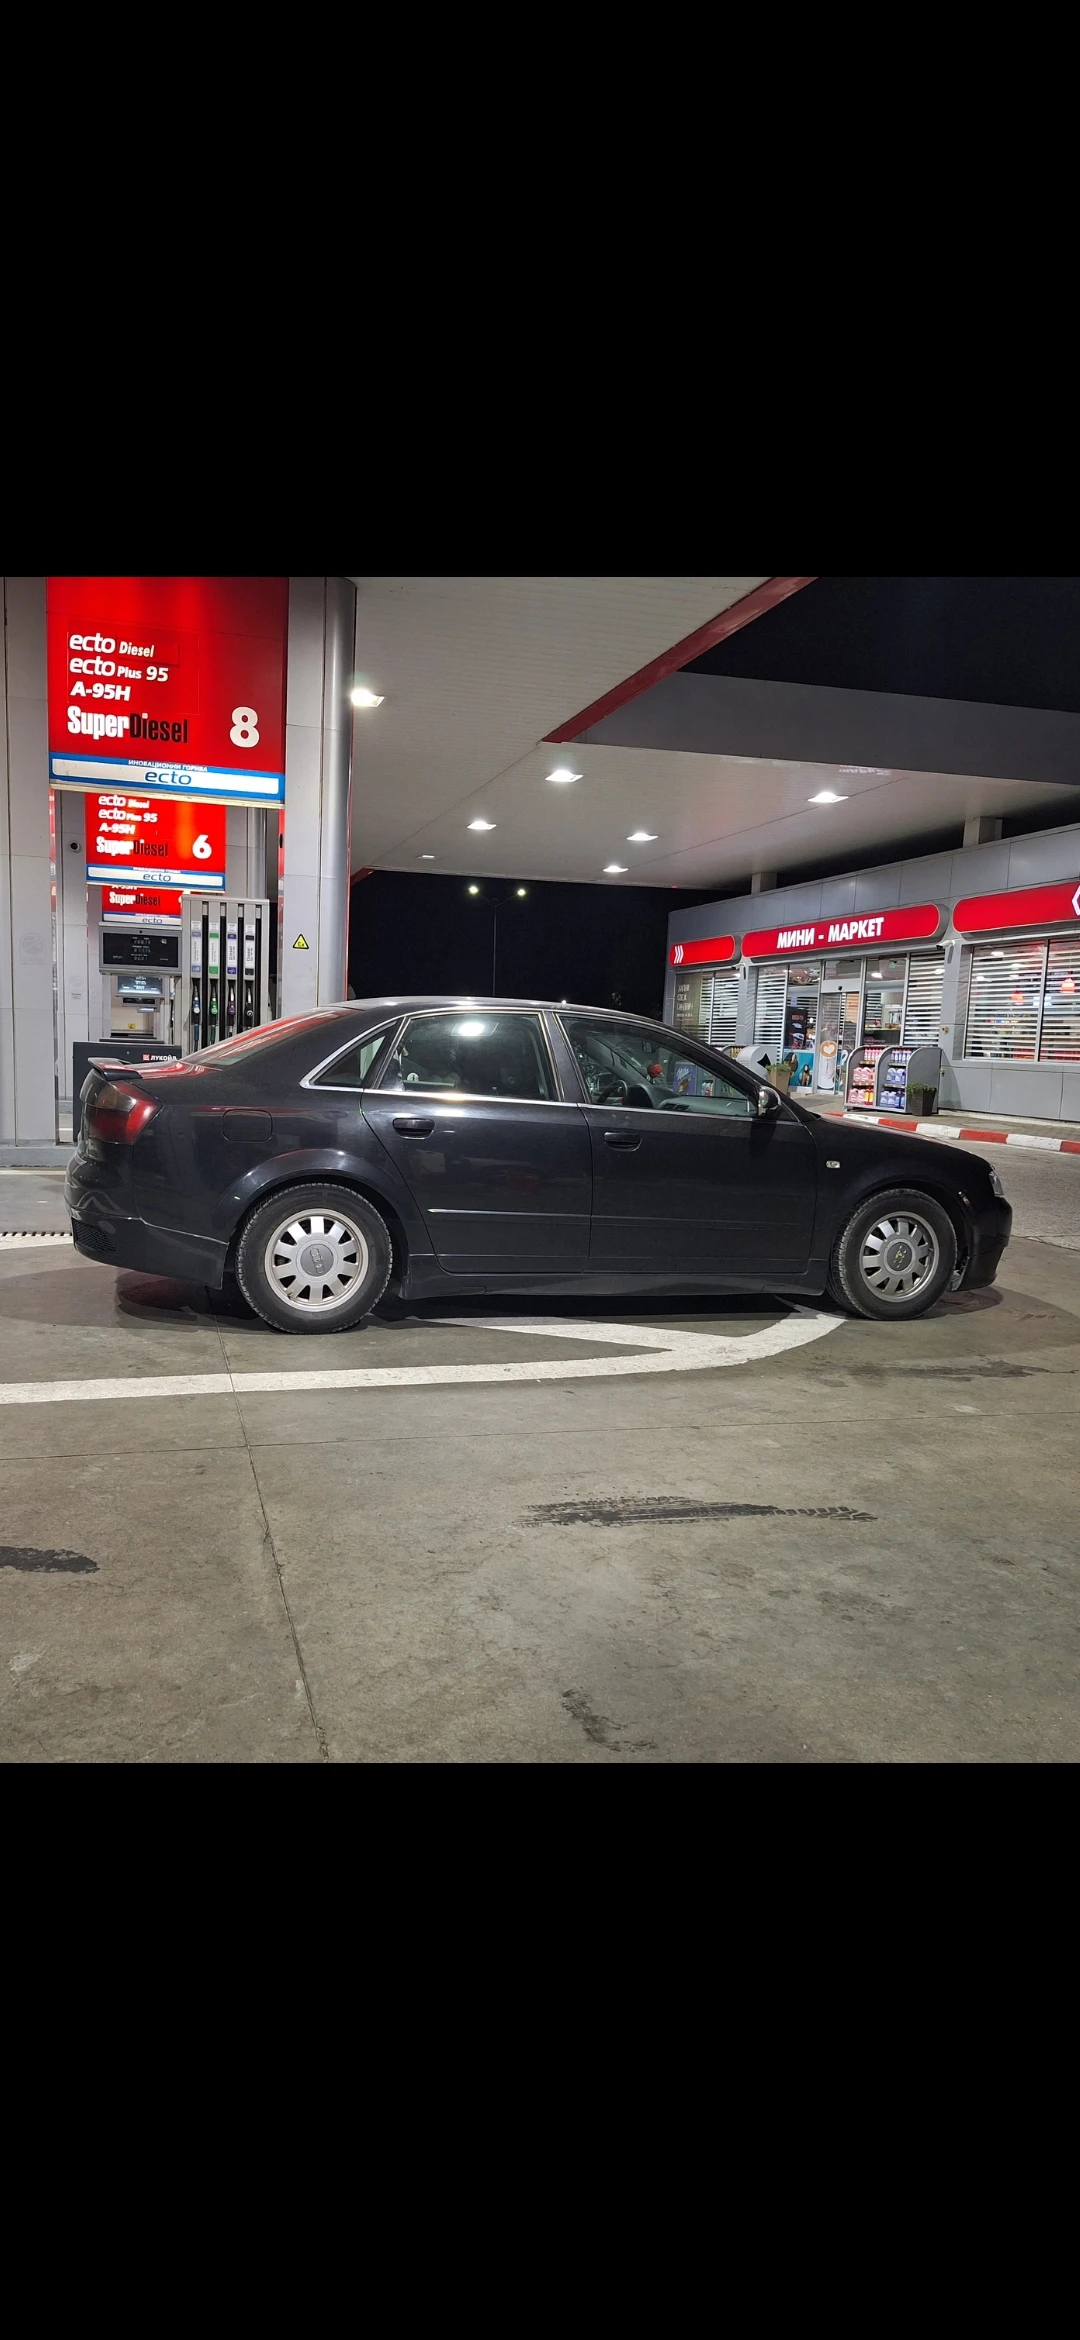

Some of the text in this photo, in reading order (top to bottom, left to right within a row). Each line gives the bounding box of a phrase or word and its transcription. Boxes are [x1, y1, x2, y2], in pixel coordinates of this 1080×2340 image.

[69, 633, 155, 658] ecto Diesel
[69, 656, 169, 682] ecto Plus 95
[229, 706, 260, 748] 8
[144, 771, 192, 785] ecto
[98, 794, 127, 807] ecto
[98, 807, 127, 820] ecto
[143, 812, 158, 823] 95
[192, 834, 213, 859] 6
[142, 873, 172, 882] ecto
[776, 927, 815, 949] МИНИ
[827, 917, 885, 943] МАРКЕТ
